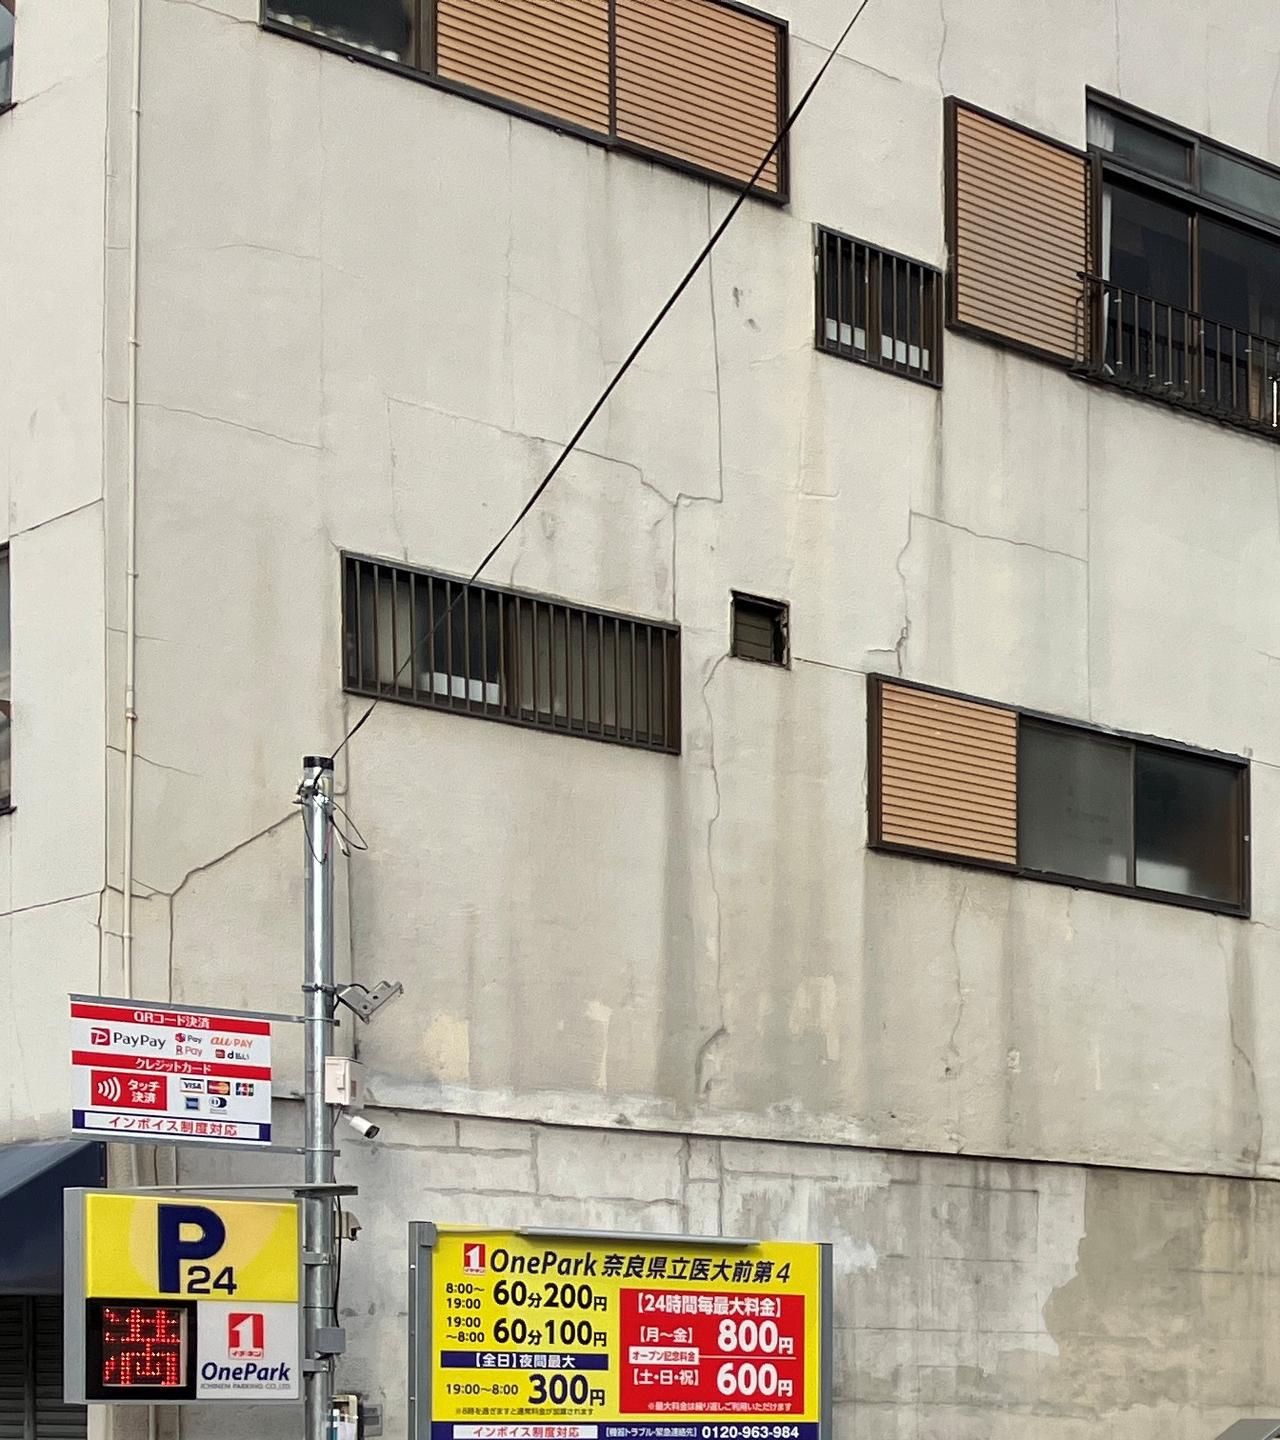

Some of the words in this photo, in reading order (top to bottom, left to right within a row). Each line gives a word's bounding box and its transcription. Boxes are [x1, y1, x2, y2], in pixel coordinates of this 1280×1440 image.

[134, 1011, 210, 1029] QRコード決済
[113, 1032, 166, 1050] PayPay
[234, 1039, 253, 1048] PAY
[135, 1058, 212, 1073] クレジットカード
[128, 1079, 160, 1091] タッチ
[184, 1081, 201, 1090] VISA
[109, 1116, 238, 1137] インボイス制度対応
[157, 1203, 226, 1293] P
[490, 1248, 598, 1277] OnePark
[187, 1265, 237, 1295] 24
[447, 1298, 481, 1309] 19:00
[447, 1316, 481, 1328] 19:00
[717, 1319, 794, 1355] 800円
[632, 1350, 696, 1362] オープン記念料金
[201, 1361, 291, 1381] OnePark
[716, 1362, 793, 1397] 600円
[528, 1374, 606, 1406] 300円
[473, 1427, 580, 1438] インボイス制度対応
[701, 1425, 800, 1440] 0120-963-984
